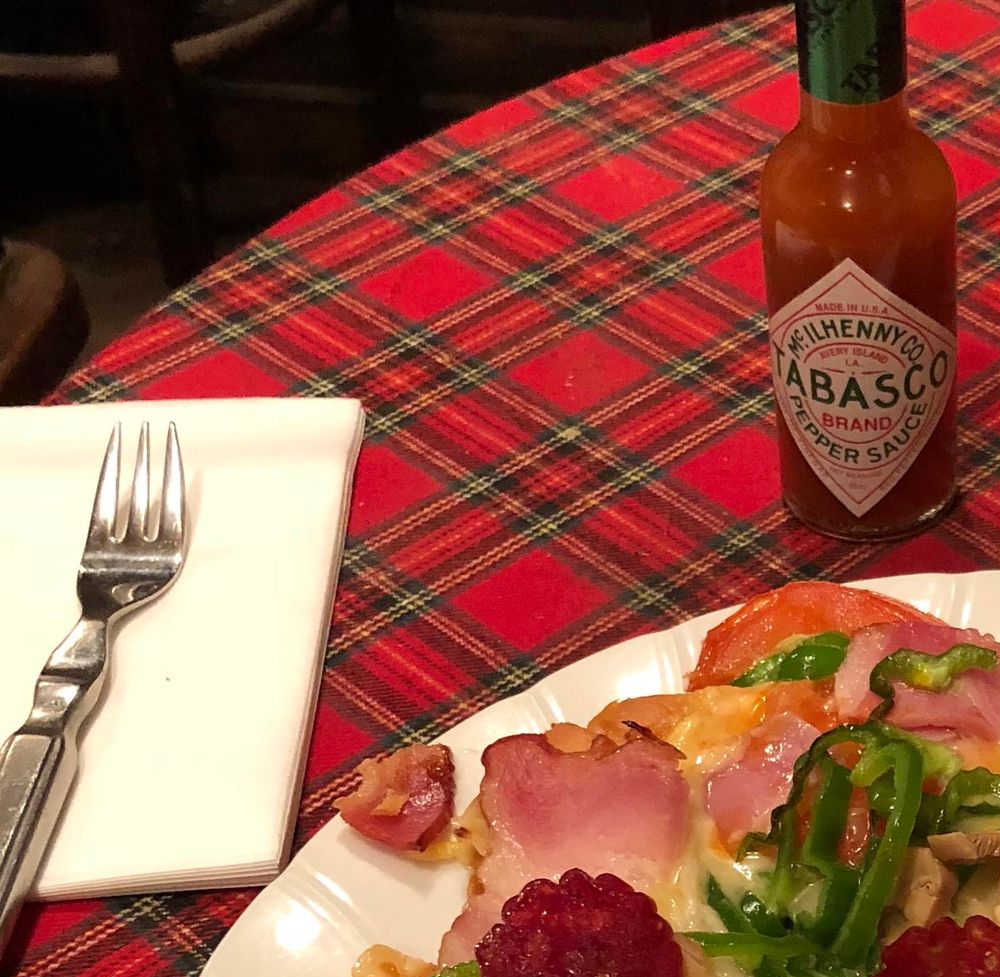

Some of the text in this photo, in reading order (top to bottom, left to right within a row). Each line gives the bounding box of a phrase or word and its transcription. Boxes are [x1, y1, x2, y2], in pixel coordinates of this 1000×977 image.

[815, 302, 844, 312] MADE
[847, 303, 858, 312] IN
[852, 348, 889, 364] ISLAND
[772, 339, 949, 410] TABASCO
[789, 395, 928, 464] PEPPER SAUCE
[822, 412, 892, 432] BRAND
